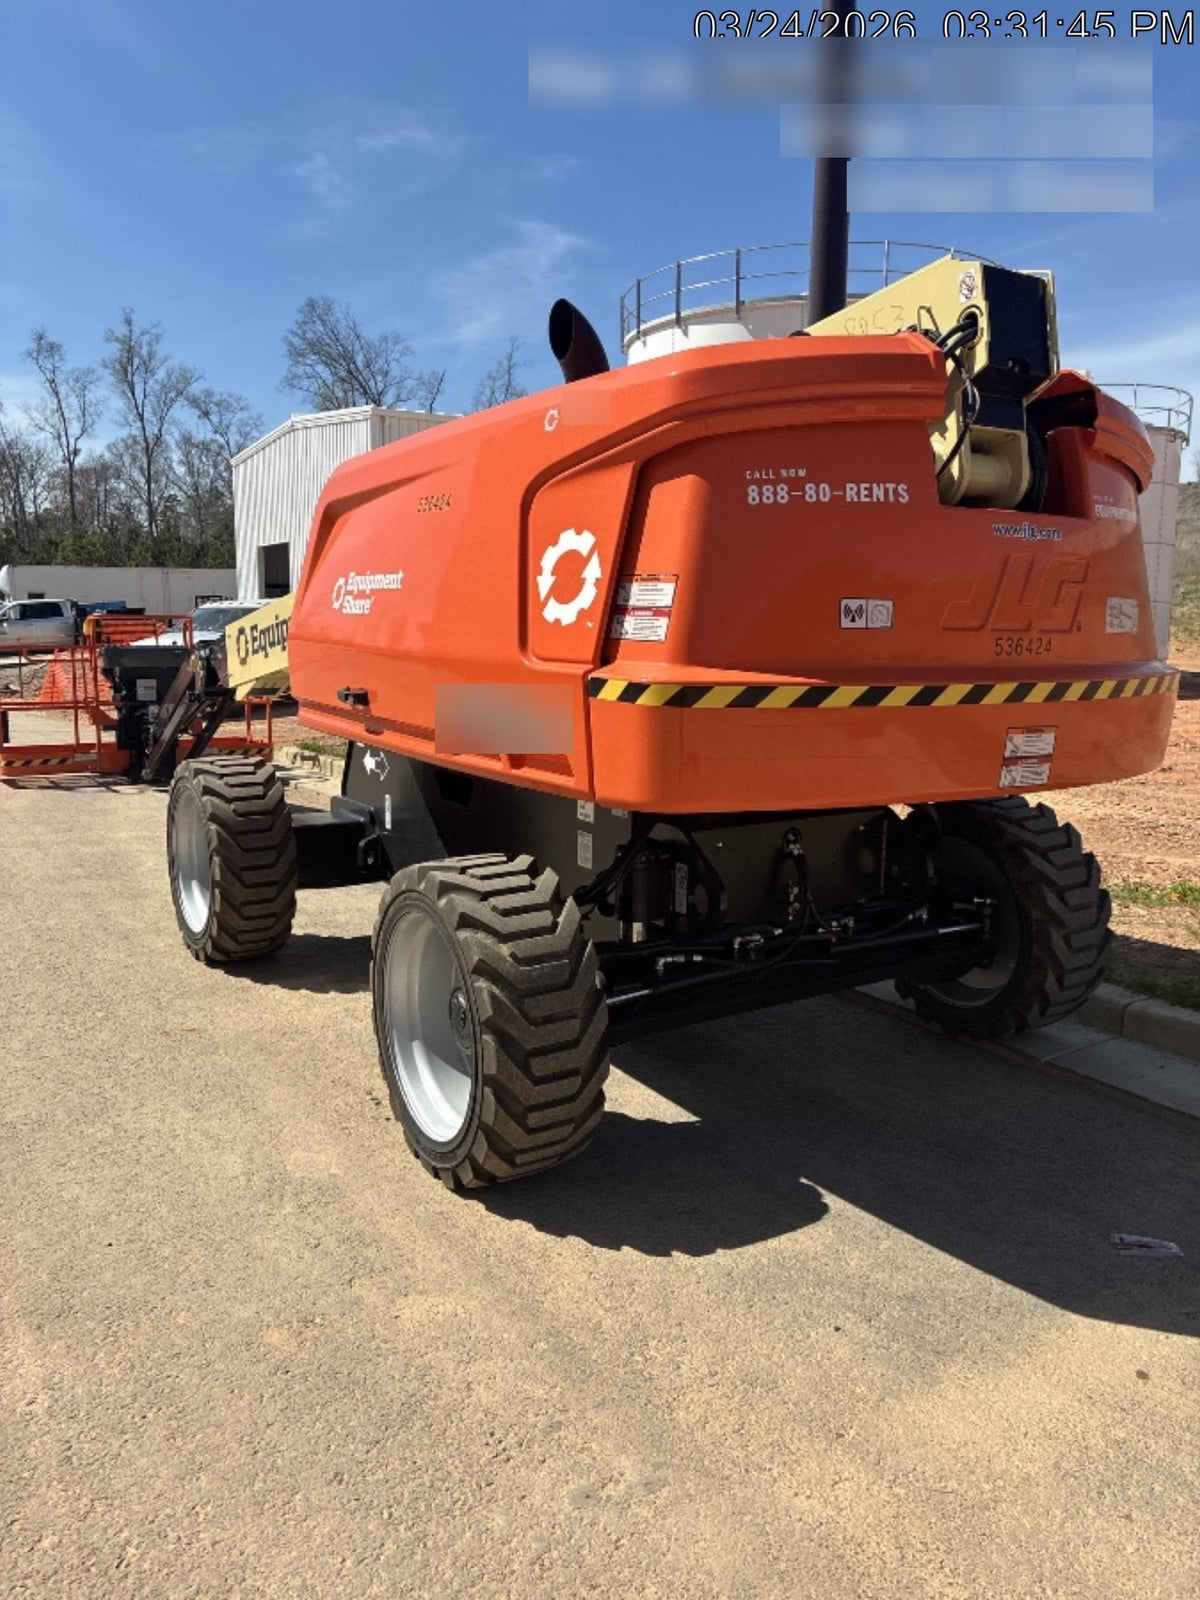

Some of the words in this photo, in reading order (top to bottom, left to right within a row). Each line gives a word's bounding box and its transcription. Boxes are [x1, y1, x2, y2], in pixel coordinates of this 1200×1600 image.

[746, 468, 776, 480] CALL
[747, 482, 910, 505] 888-80-RENTS
[249, 613, 291, 659] Equip
[993, 636, 1053, 656] 536424
